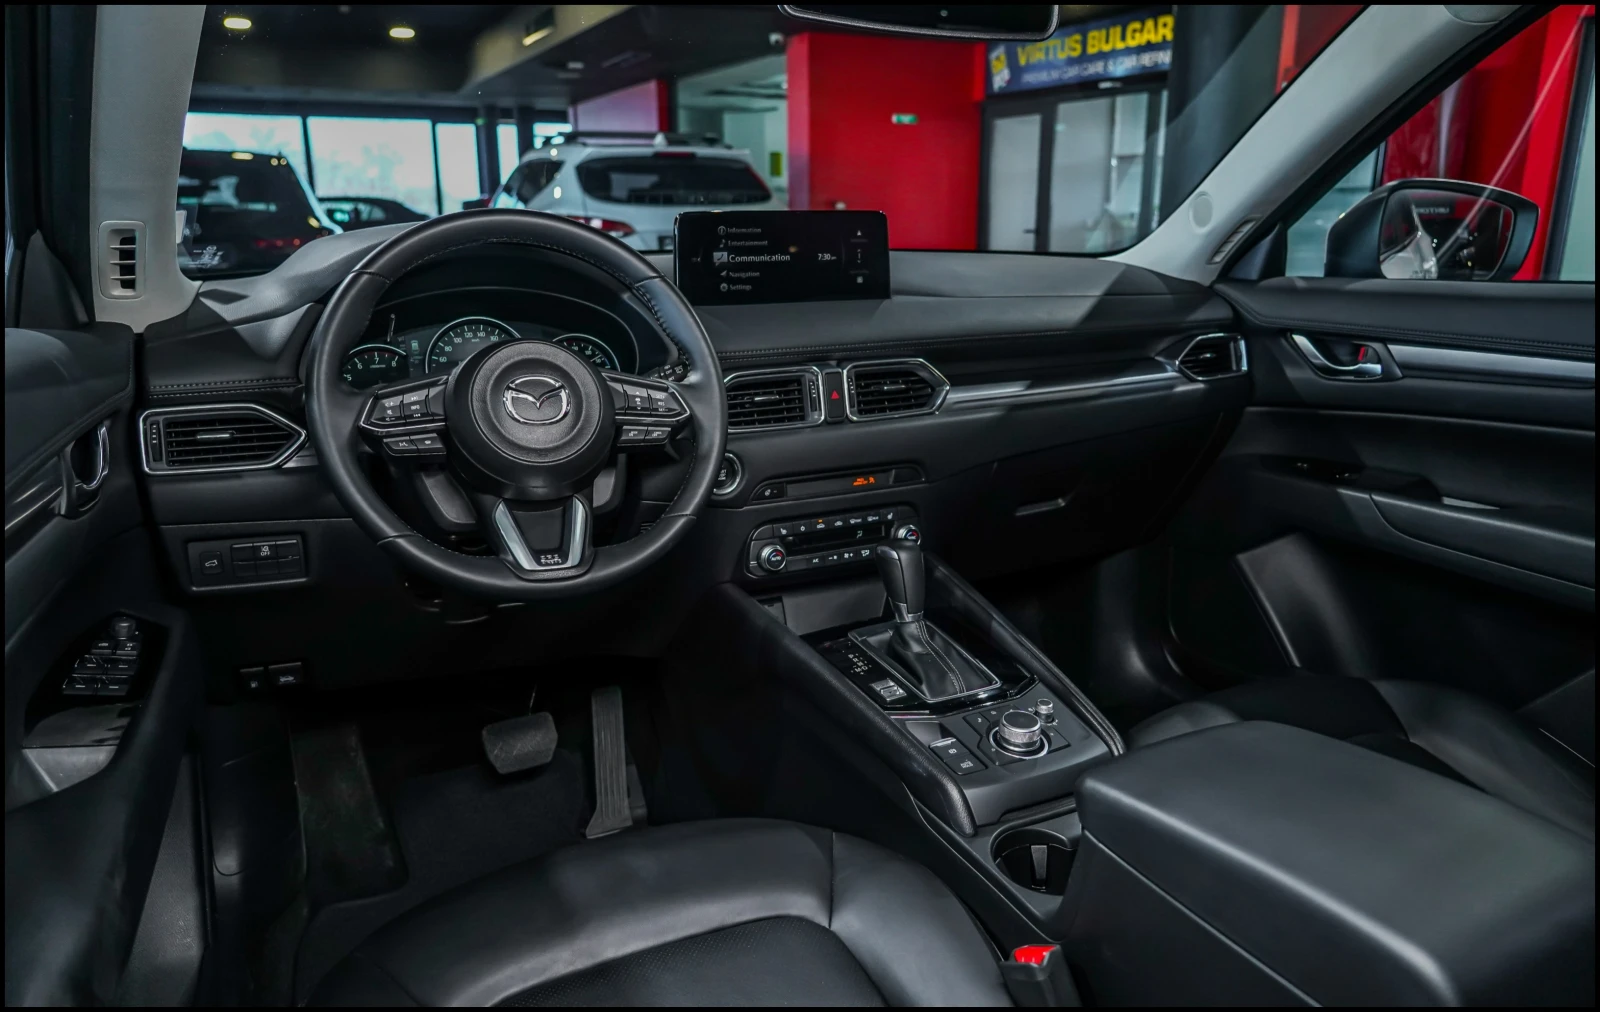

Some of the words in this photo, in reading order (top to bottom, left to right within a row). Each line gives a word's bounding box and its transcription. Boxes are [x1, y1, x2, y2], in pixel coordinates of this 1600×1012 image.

[1017, 33, 1082, 66] VIRTUS
[1086, 14, 1174, 55] BULGAR
[729, 253, 790, 263] Communication
[729, 270, 760, 278] Navigation
[730, 283, 752, 291] Settings
